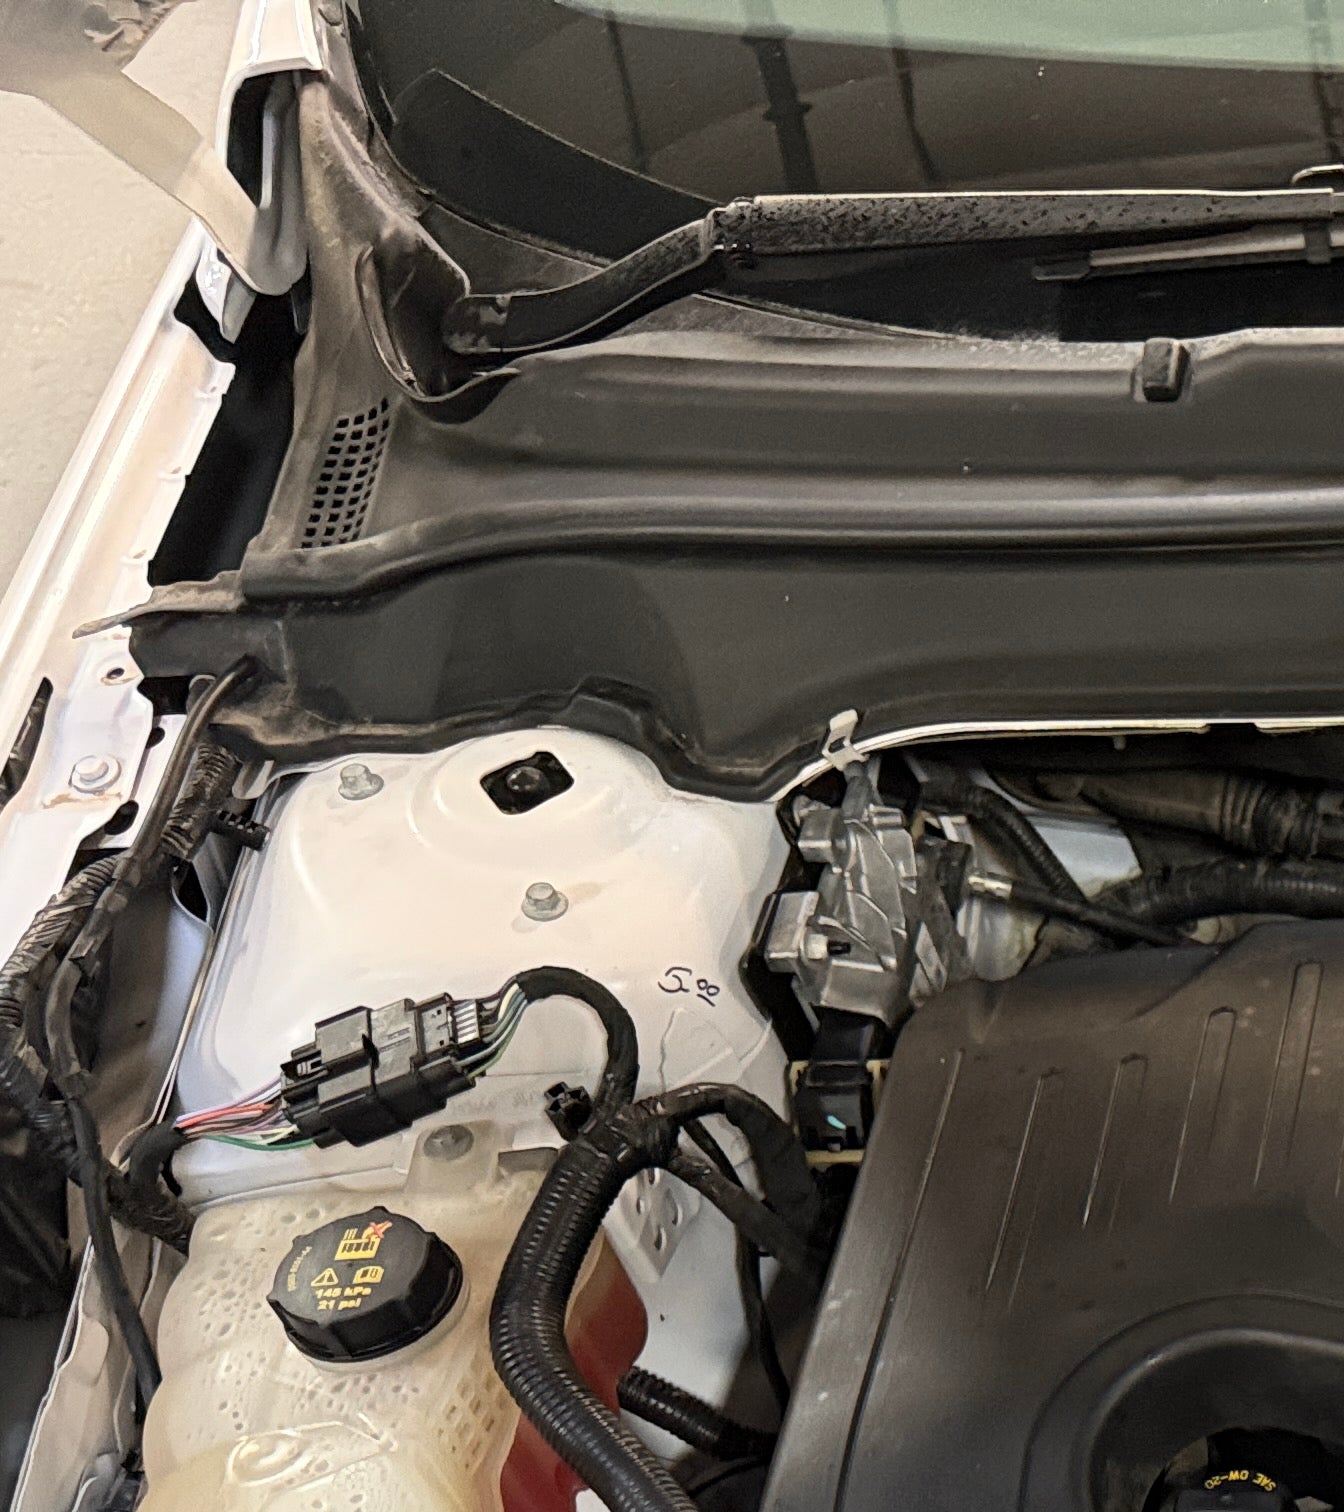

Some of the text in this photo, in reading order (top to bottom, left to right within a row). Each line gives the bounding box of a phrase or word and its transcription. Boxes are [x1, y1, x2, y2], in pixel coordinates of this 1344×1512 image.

[315, 1286, 372, 1299] 145 kPa
[317, 1298, 361, 1310] 21 psi
[1204, 1469, 1277, 1492] SAE 0W-20
